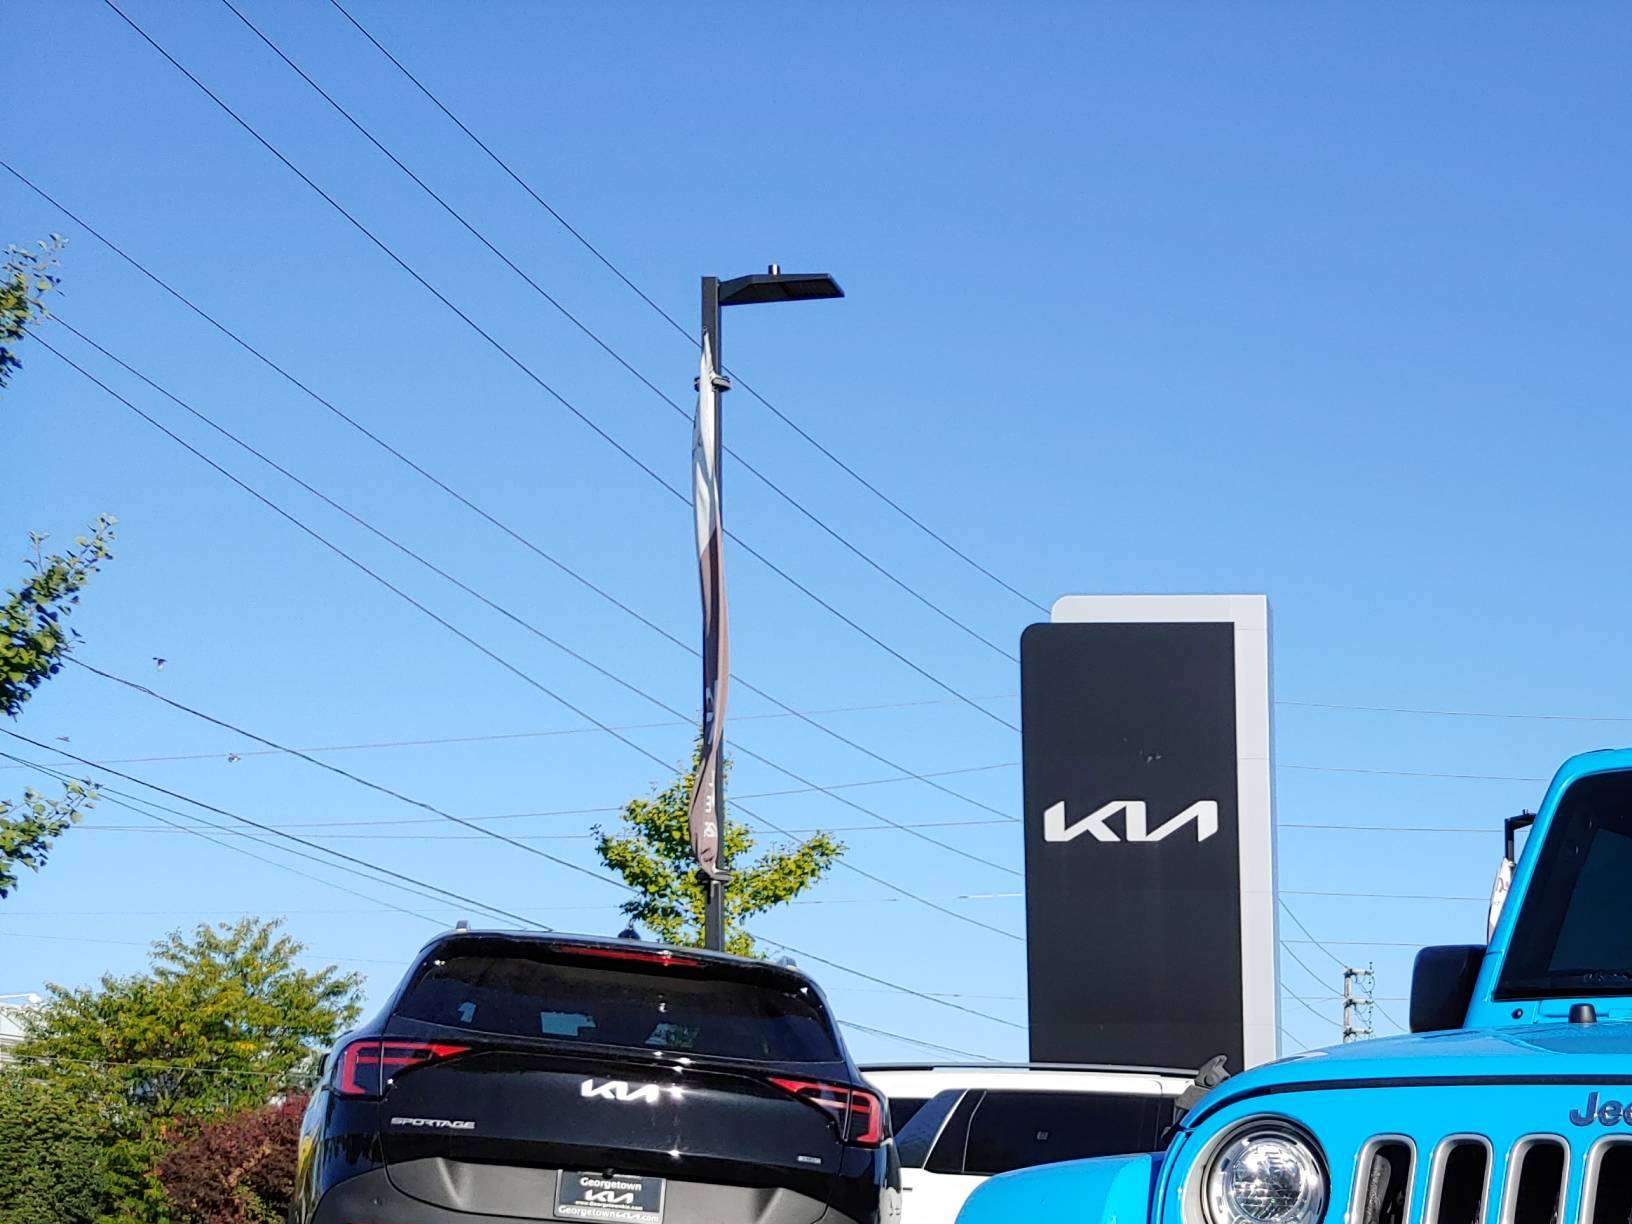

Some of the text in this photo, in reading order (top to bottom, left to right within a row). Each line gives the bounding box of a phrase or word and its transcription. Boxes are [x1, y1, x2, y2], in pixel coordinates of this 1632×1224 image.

[1043, 800, 1219, 842] KIA
[580, 1078, 660, 1103] KIA
[391, 1117, 475, 1129] SPORTAGE
[580, 1177, 642, 1191] Georgetown
[585, 1189, 634, 1203] KIA
